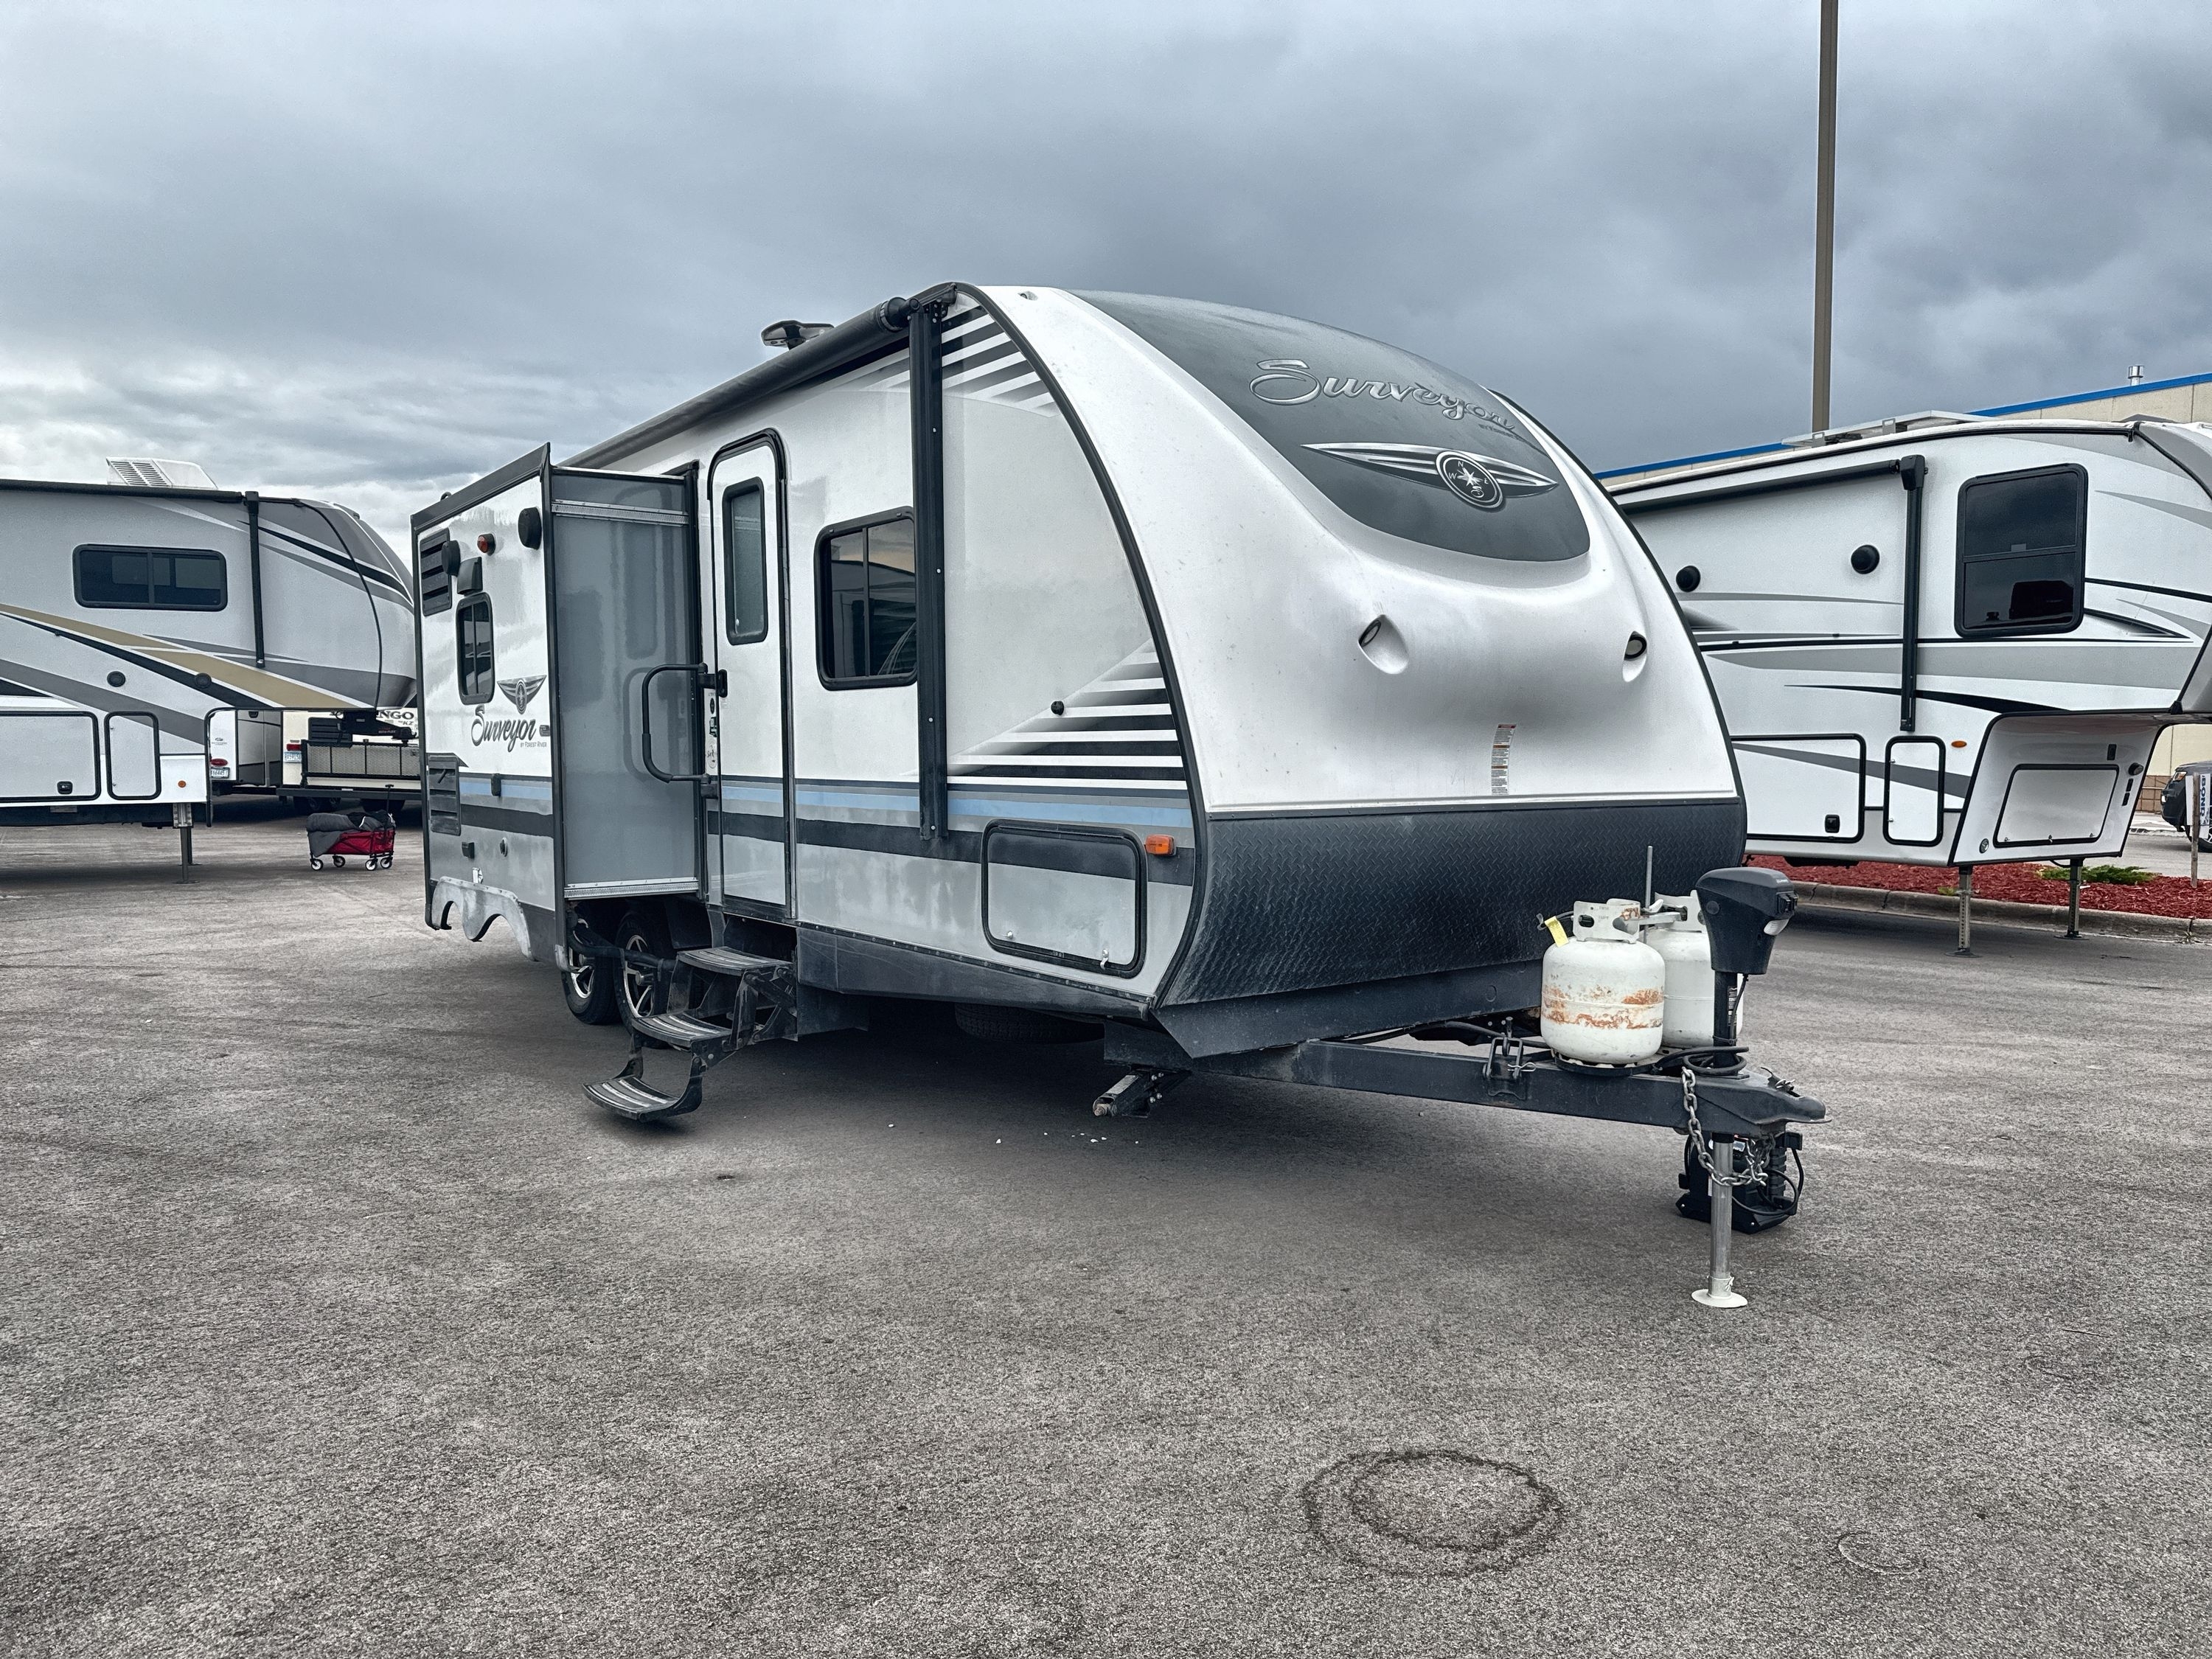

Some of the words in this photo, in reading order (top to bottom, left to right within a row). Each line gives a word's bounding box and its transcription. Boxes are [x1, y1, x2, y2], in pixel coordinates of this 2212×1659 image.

[1249, 358, 1515, 430] Surveyor
[375, 709, 414, 720] NGO
[470, 703, 537, 753] Surveyor
